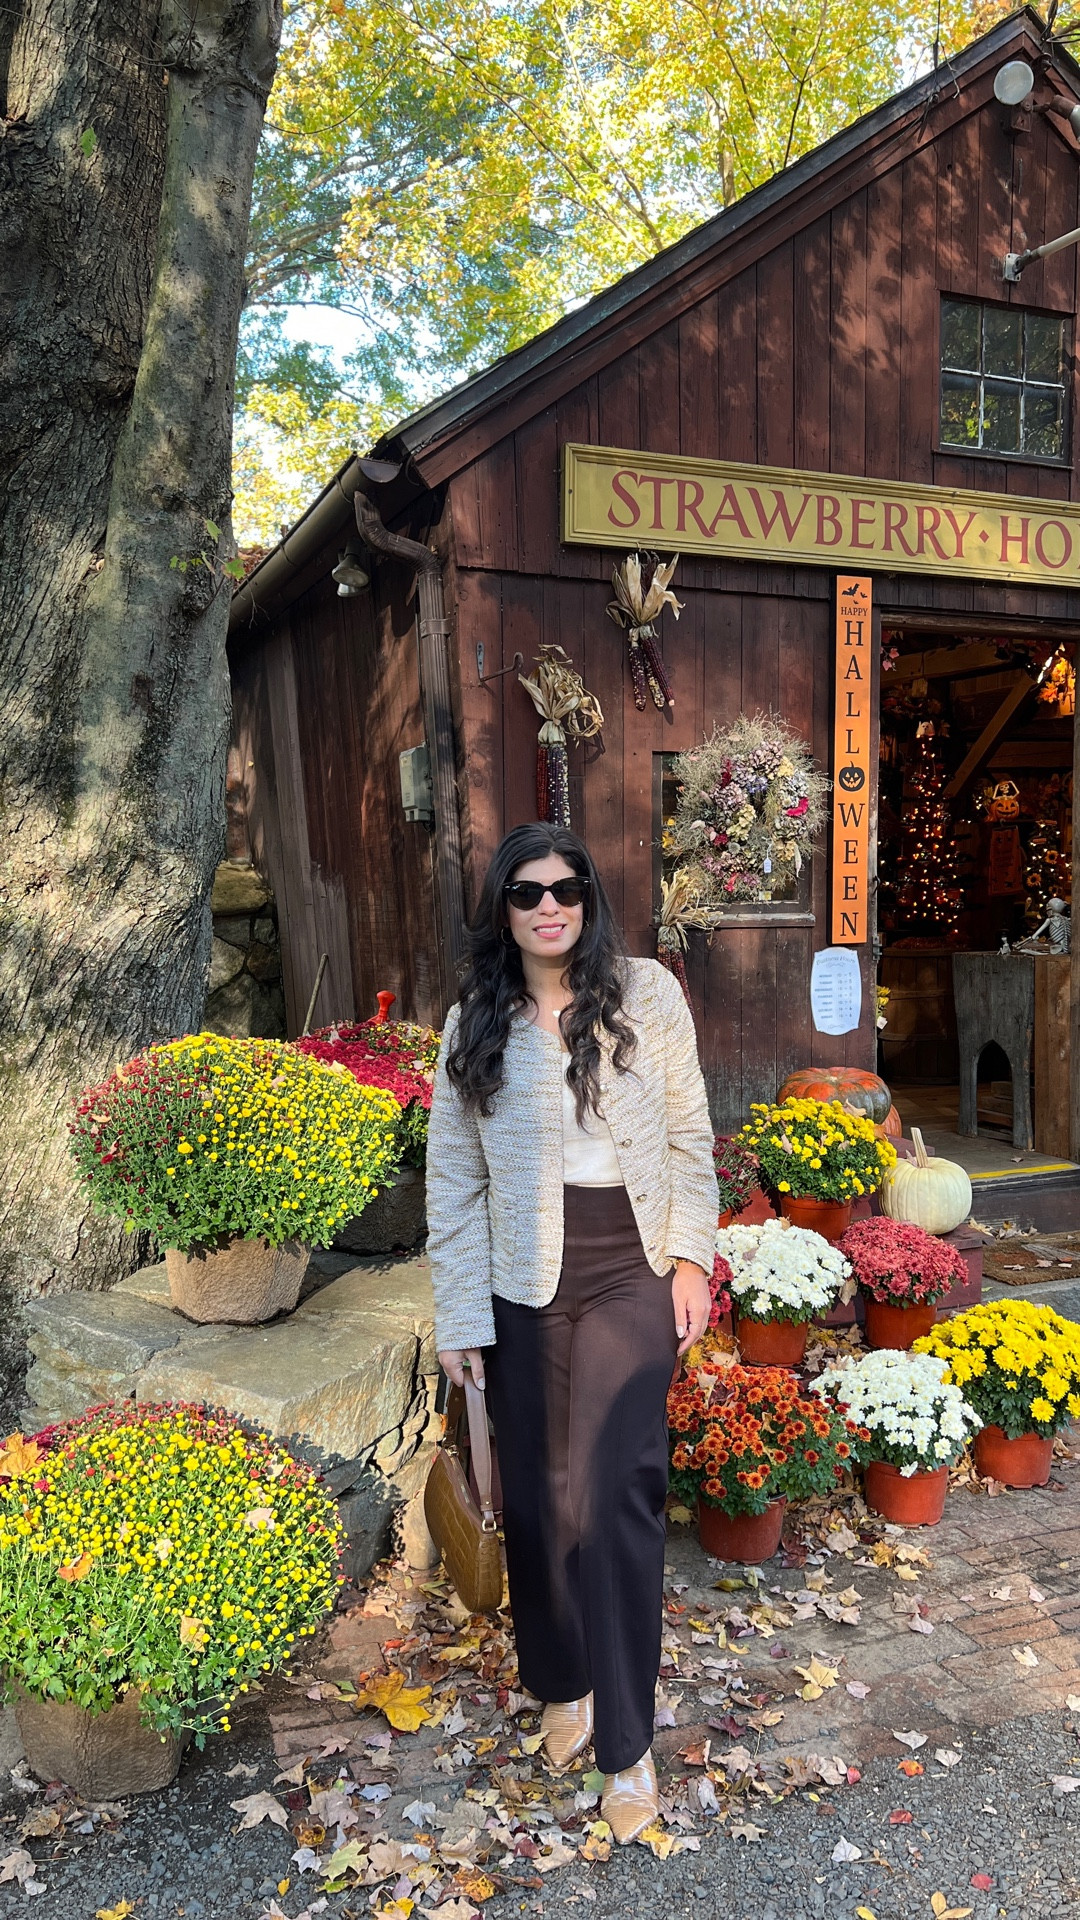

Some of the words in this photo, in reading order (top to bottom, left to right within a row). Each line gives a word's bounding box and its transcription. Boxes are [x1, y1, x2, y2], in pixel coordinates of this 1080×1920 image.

[608, 470, 978, 560] STRAWBERRY
[999, 515, 1080, 569] HO
[841, 606, 869, 617] HAPPY
